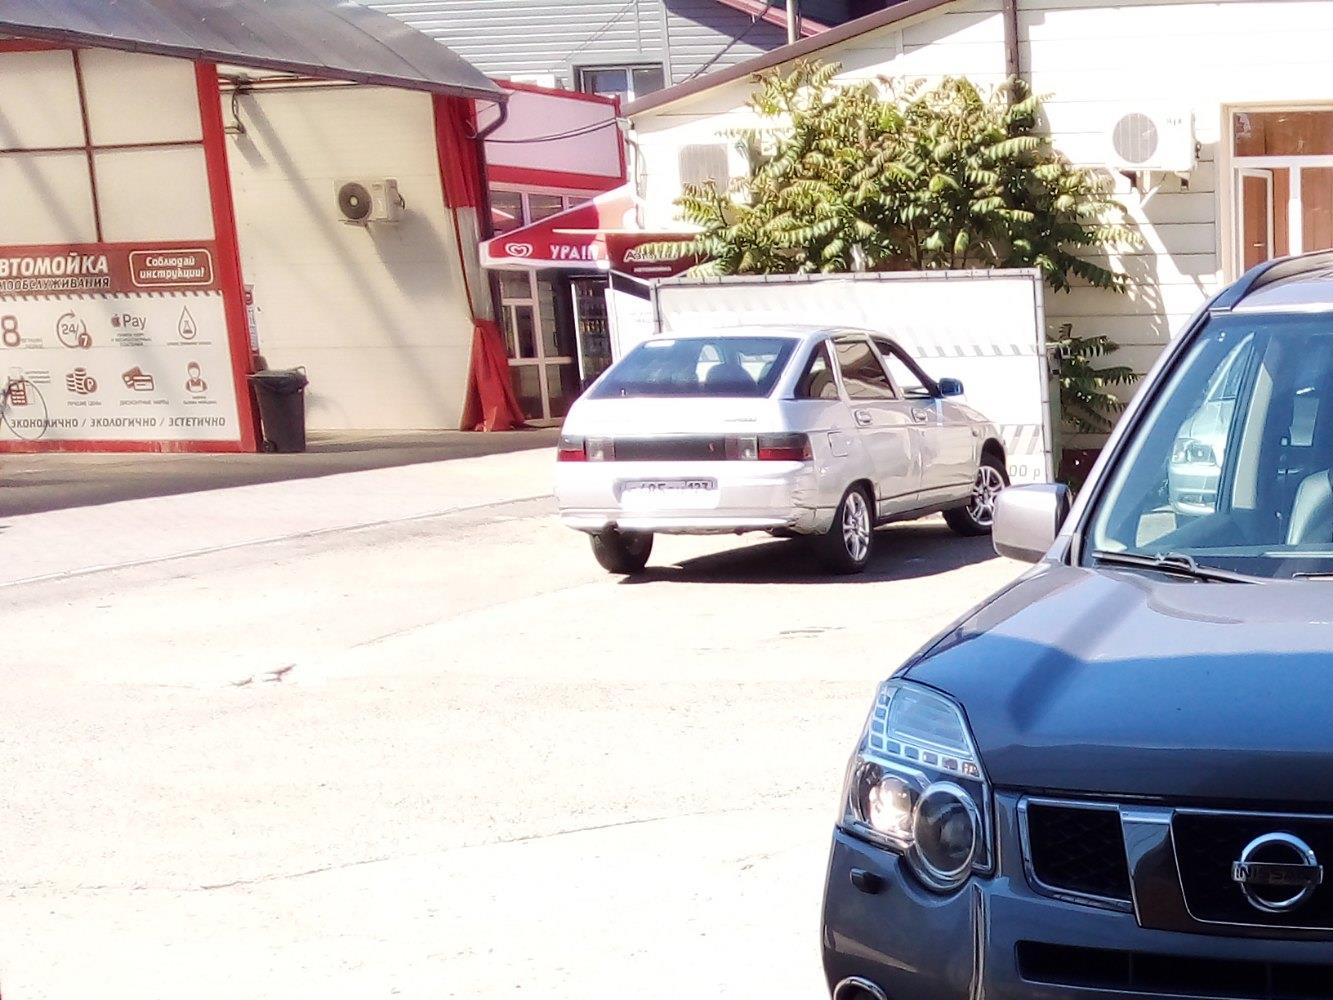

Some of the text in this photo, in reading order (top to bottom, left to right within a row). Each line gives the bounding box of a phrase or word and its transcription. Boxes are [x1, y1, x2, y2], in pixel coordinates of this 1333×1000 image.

[146, 256, 195, 267] Соблюдай
[140, 267, 205, 279] инструкции!
[122, 313, 146, 330] Pay
[2, 315, 20, 346] 8
[11, 418, 78, 428] ЭКОНОМИЧНО
[90, 417, 156, 428] ЭКОЛОГИЧНО
[168, 416, 226, 427] ЭСТЕТИЧНО
